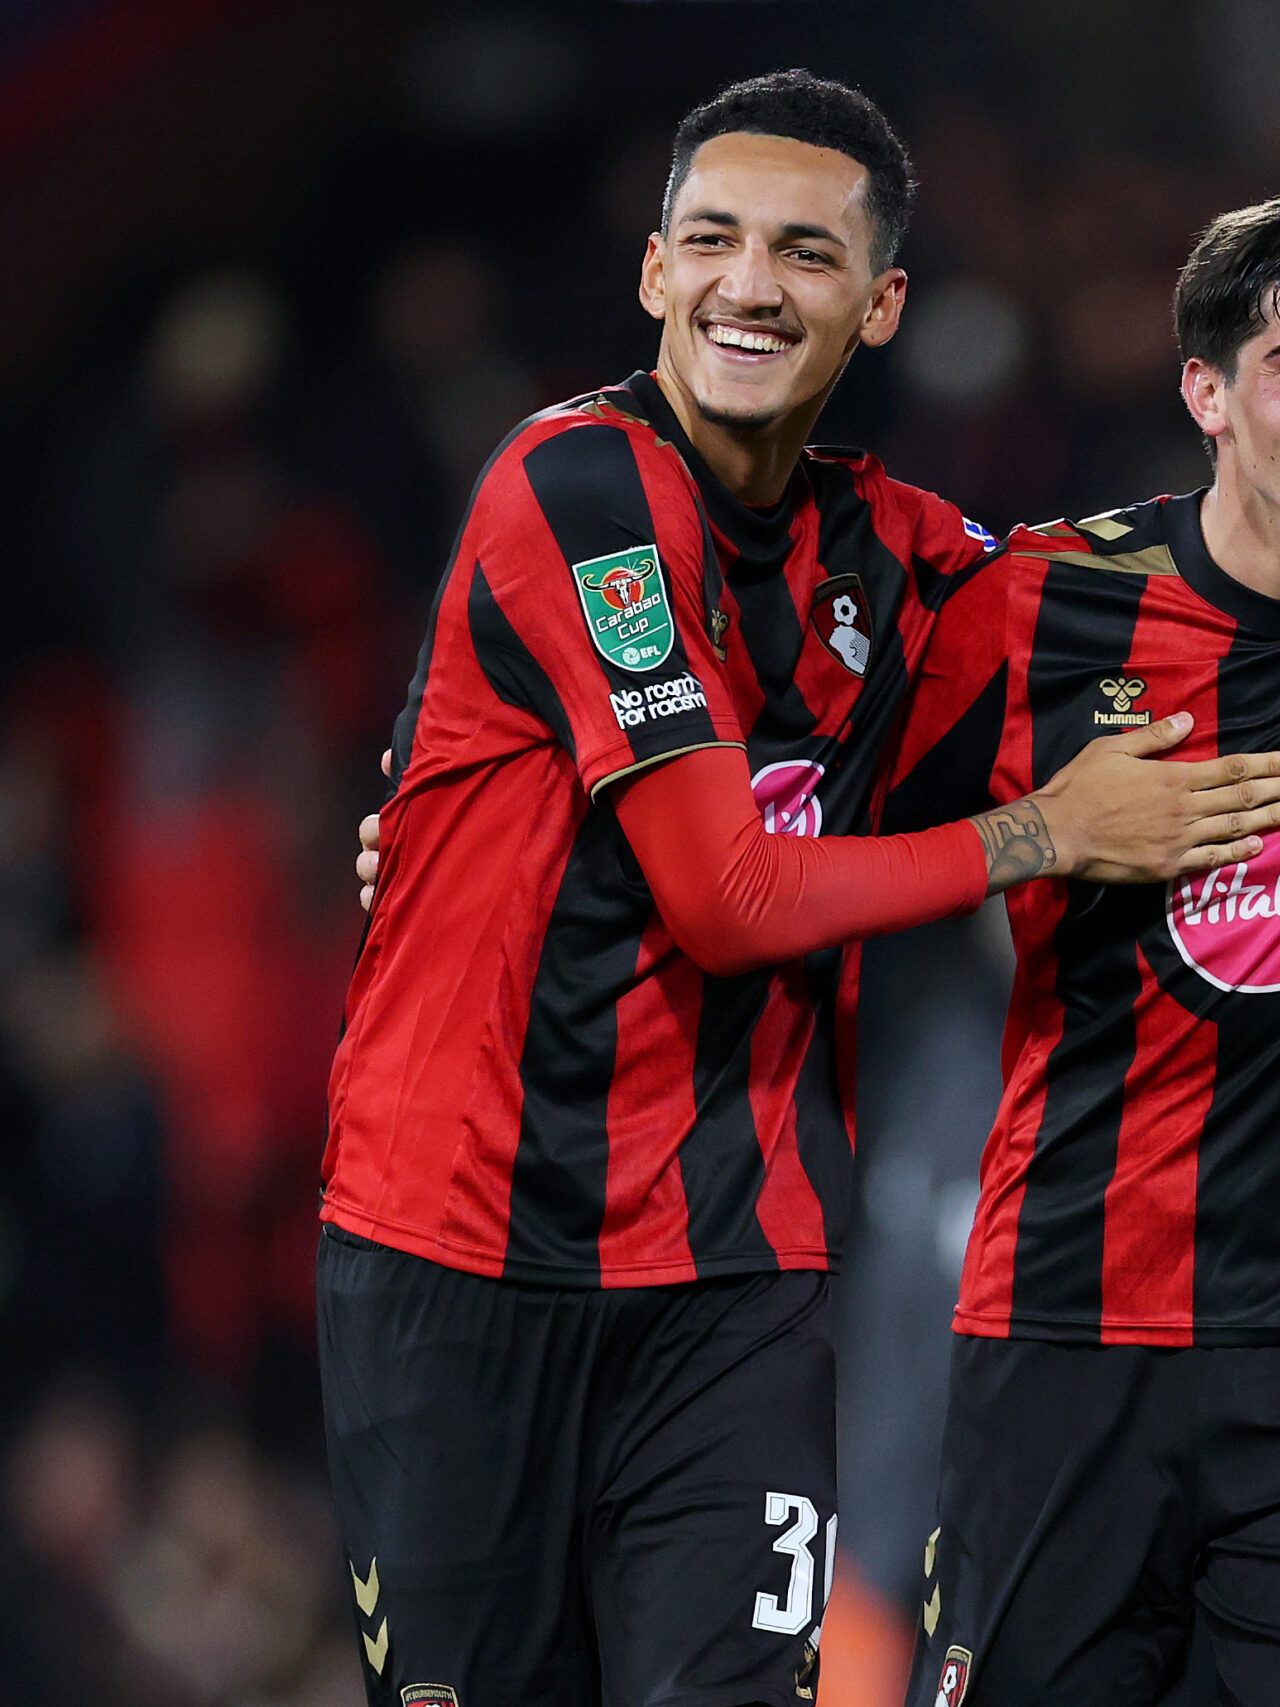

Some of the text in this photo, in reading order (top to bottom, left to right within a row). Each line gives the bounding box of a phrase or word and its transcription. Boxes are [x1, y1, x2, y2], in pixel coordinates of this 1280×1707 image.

[595, 593, 661, 633] Carabao
[617, 617, 649, 640] Cup
[640, 645, 661, 659] EFL
[609, 677, 697, 711] No room
[615, 691, 707, 730] for racism
[1094, 710, 1150, 725] hummel
